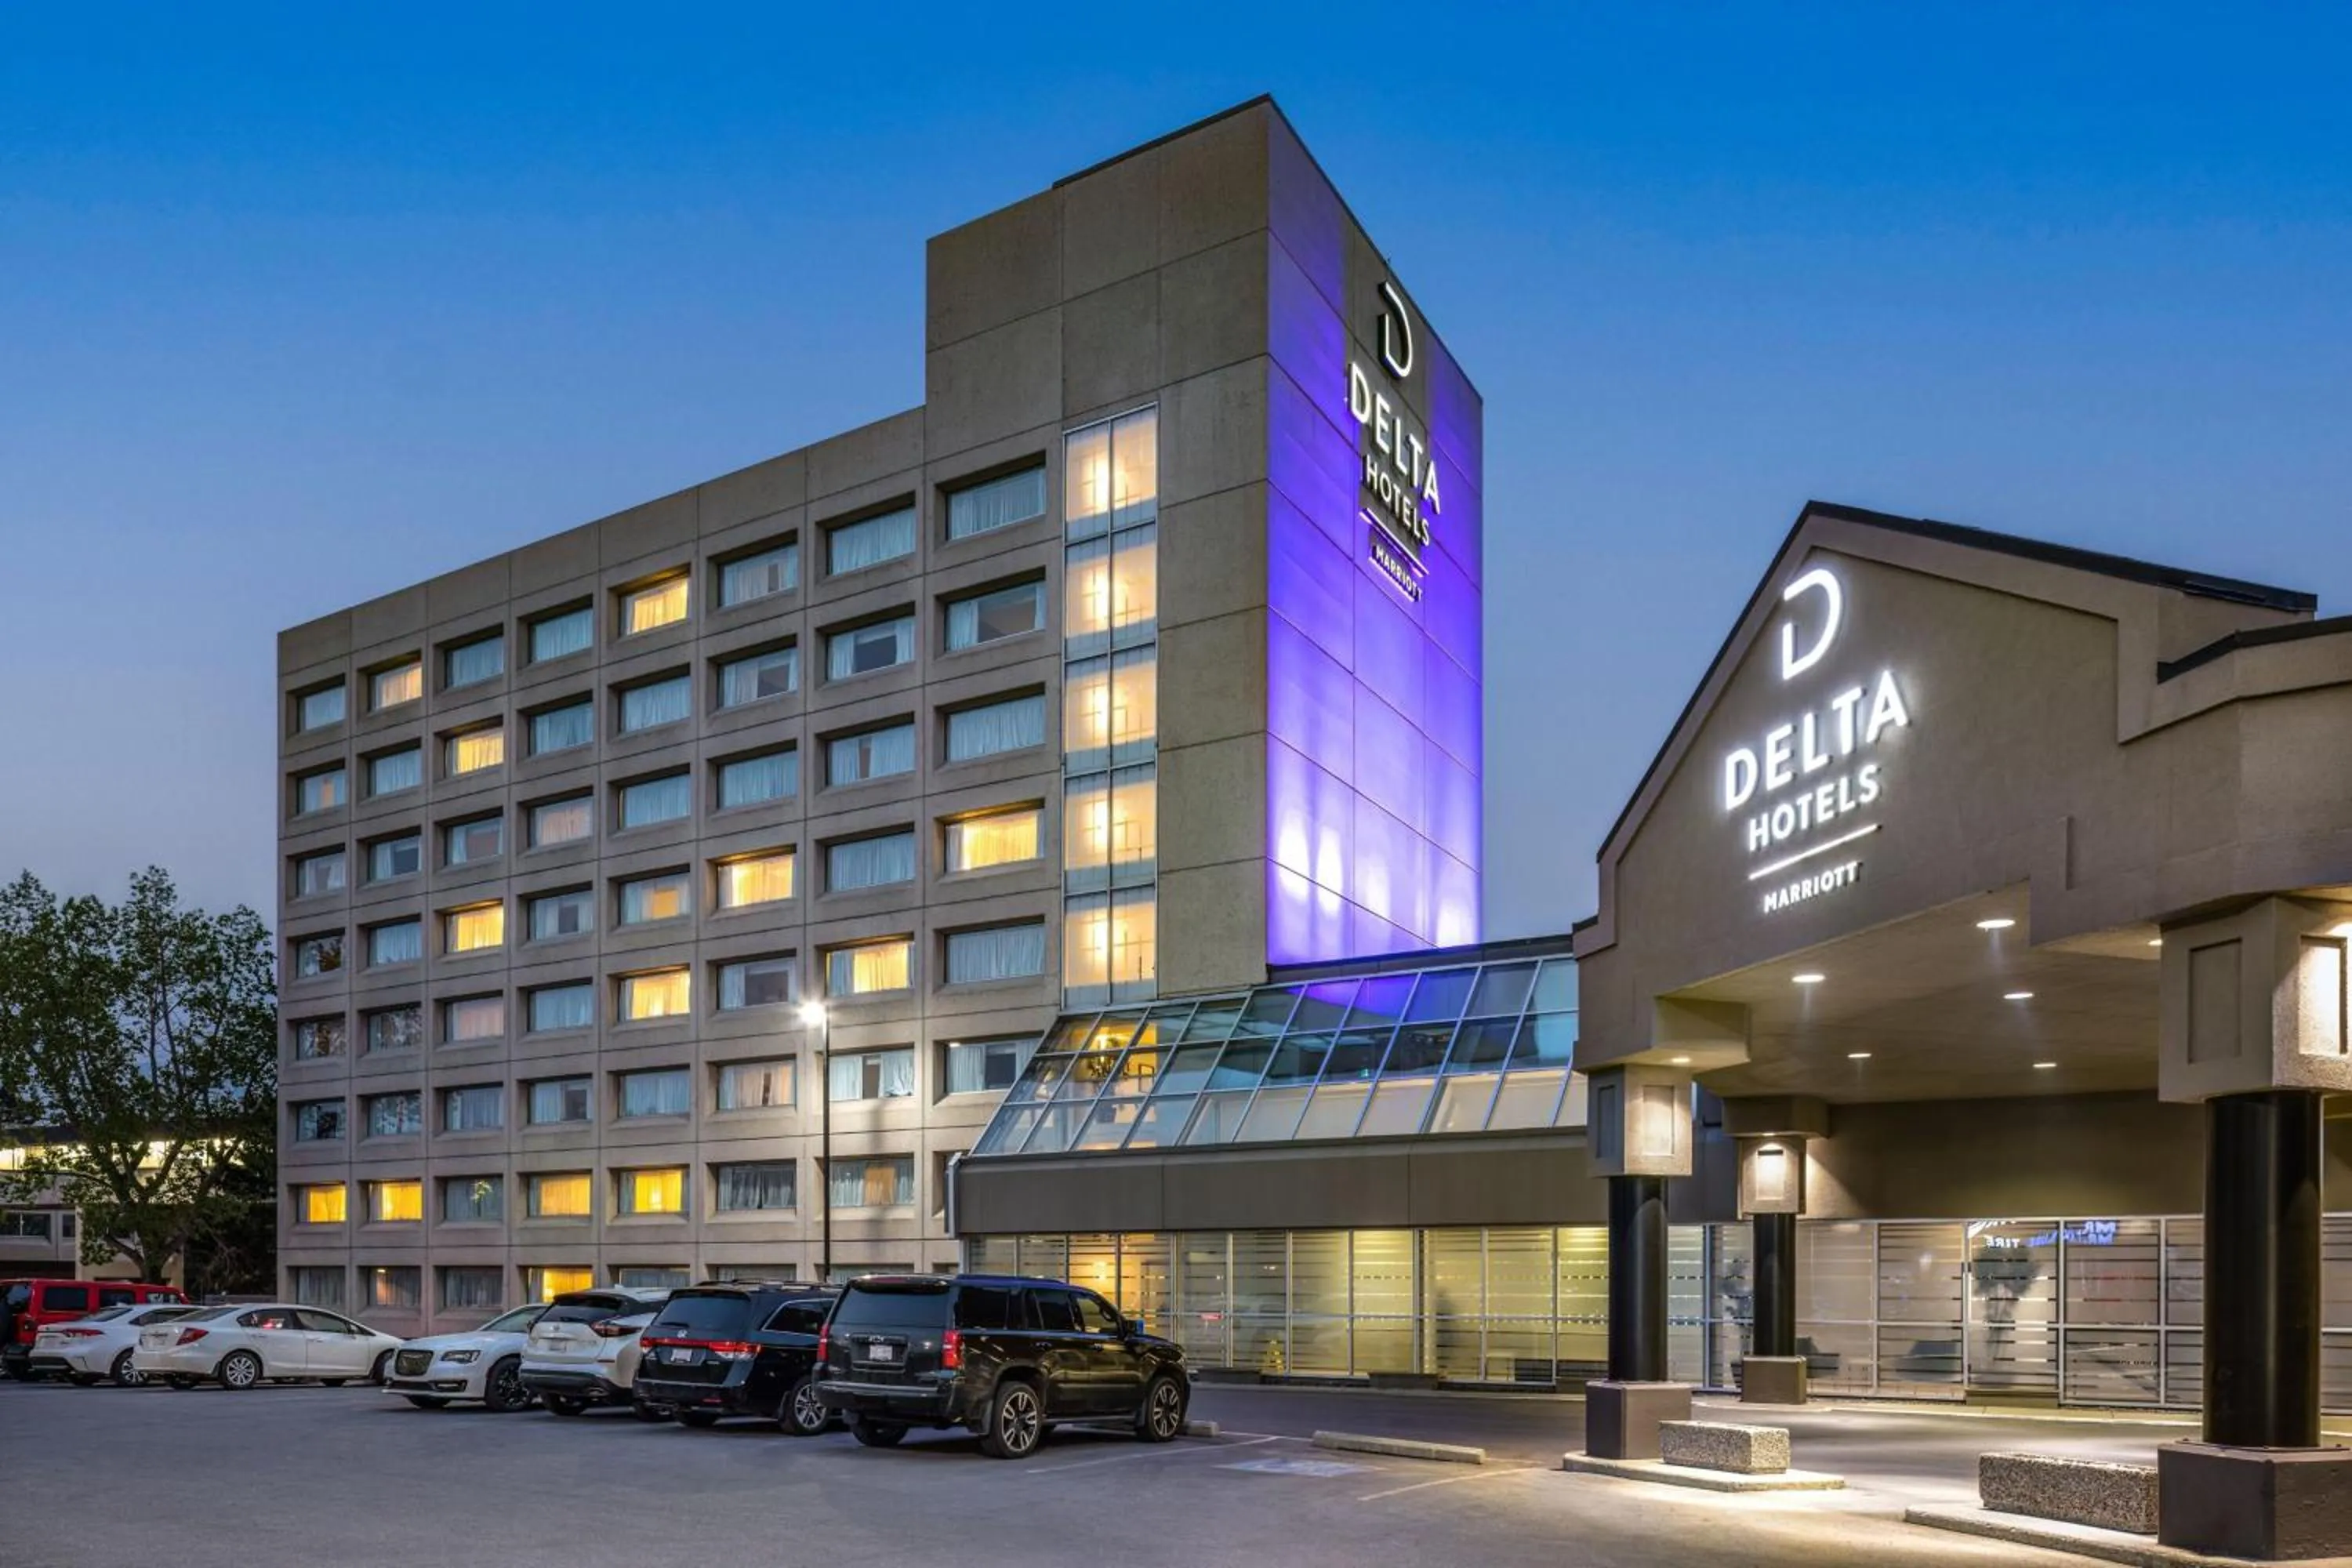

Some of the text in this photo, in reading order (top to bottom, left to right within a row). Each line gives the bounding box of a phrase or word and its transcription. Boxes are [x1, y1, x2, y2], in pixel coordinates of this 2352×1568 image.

[1348, 361, 1441, 514] DELTA
[1363, 454, 1429, 546] HOTELS
[1374, 543, 1423, 602] MARRIOTT
[1725, 670, 1910, 811] DELTA
[1748, 763, 1880, 852] HOTELS
[1763, 862, 1860, 914] MARRIOTT
